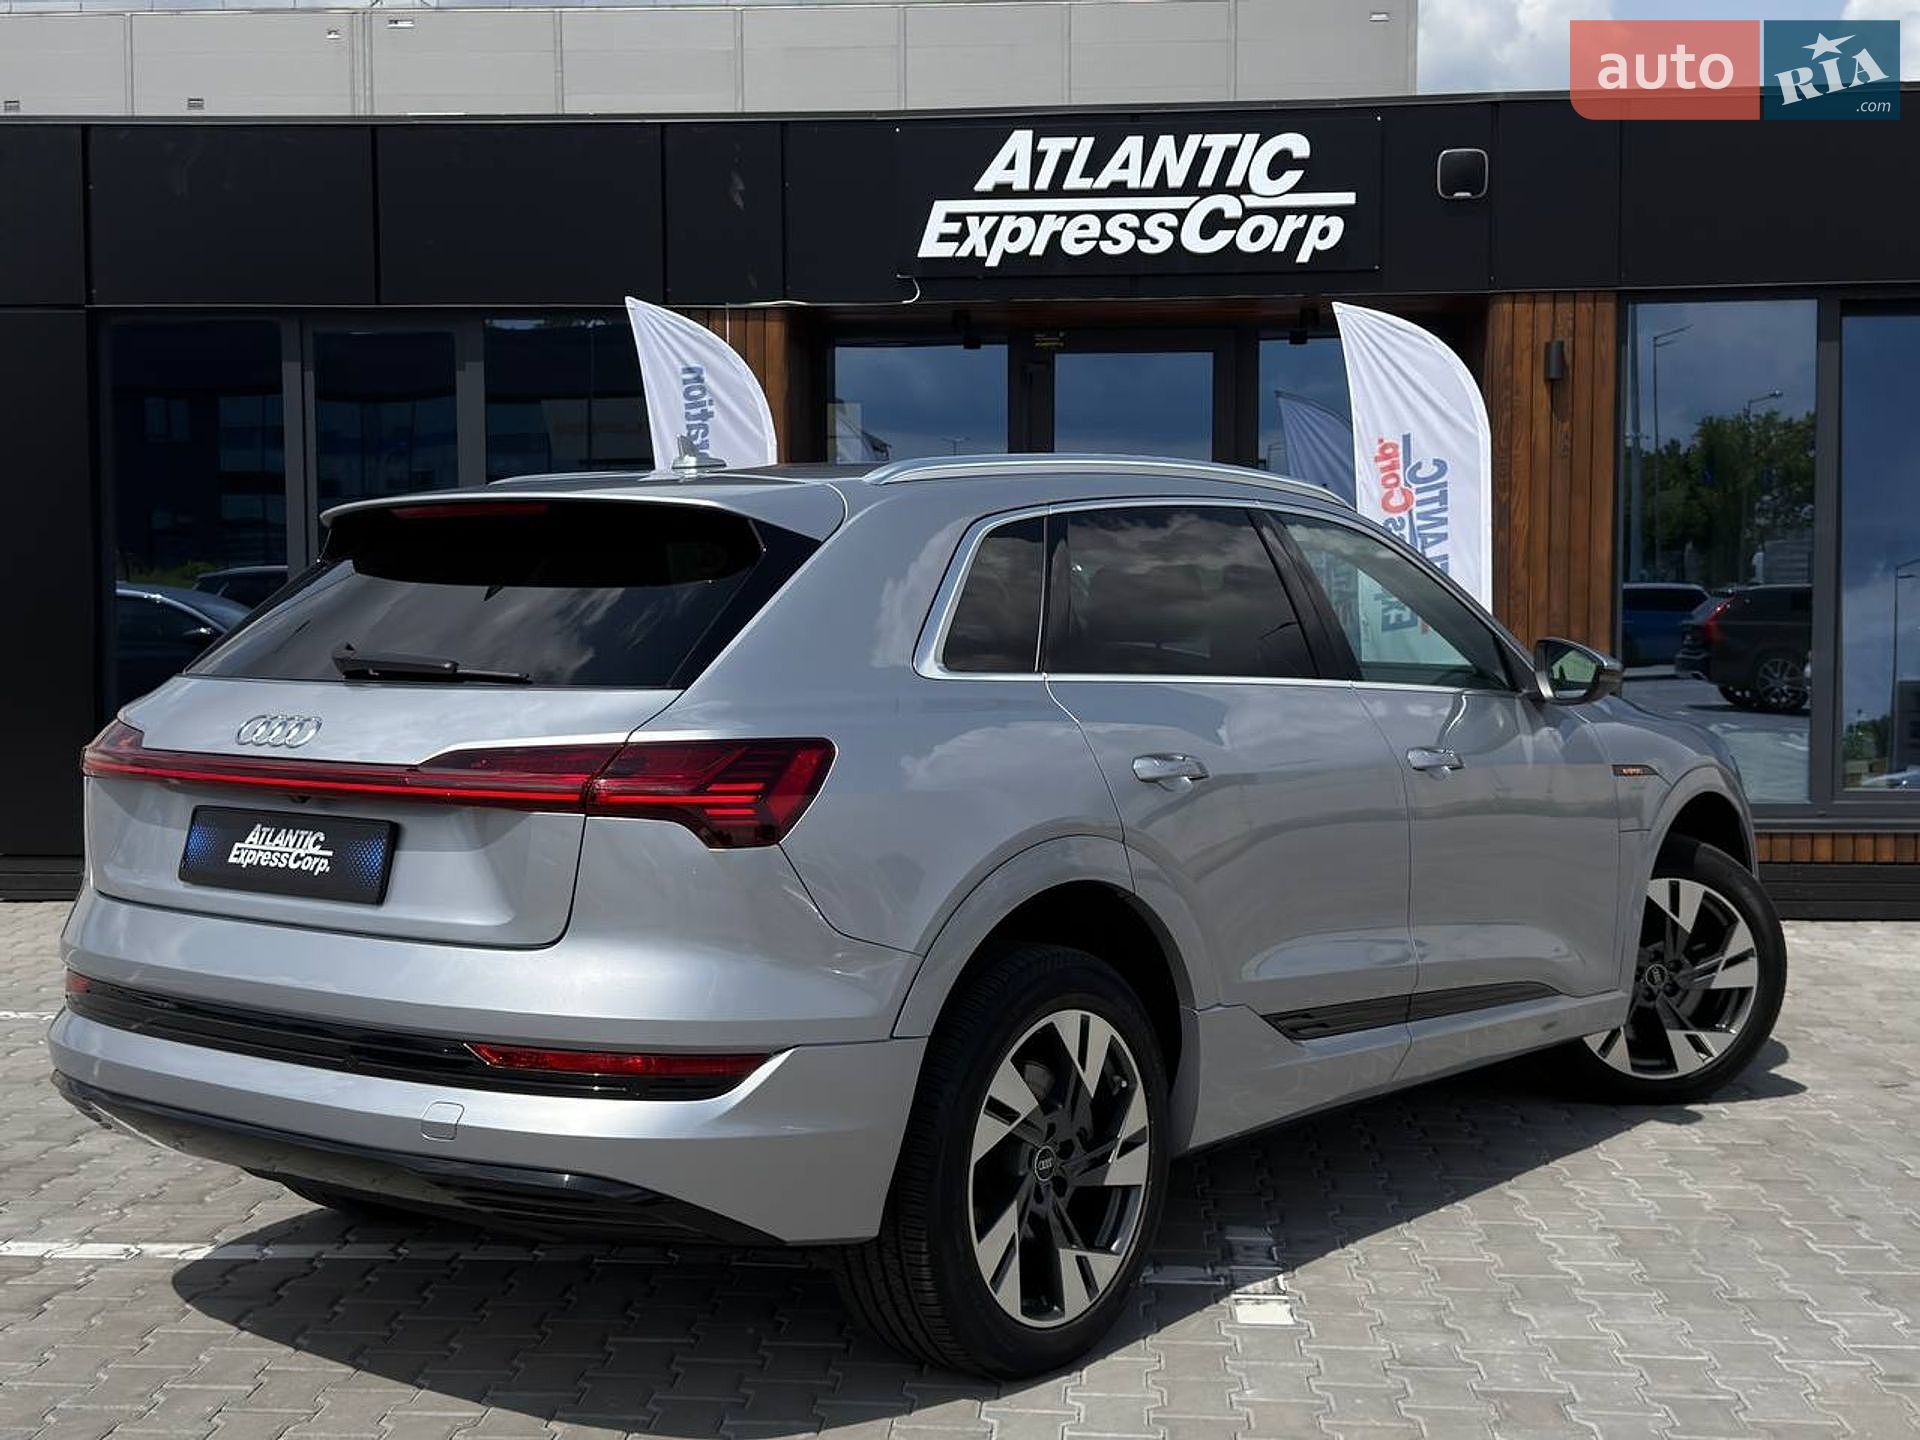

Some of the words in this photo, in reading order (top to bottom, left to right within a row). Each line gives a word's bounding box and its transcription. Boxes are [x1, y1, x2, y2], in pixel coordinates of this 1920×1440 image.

[974, 129, 1311, 196] ATLANTIC
[917, 194, 1345, 267] ExpressCorp
[245, 824, 325, 851] ATLANTIC
